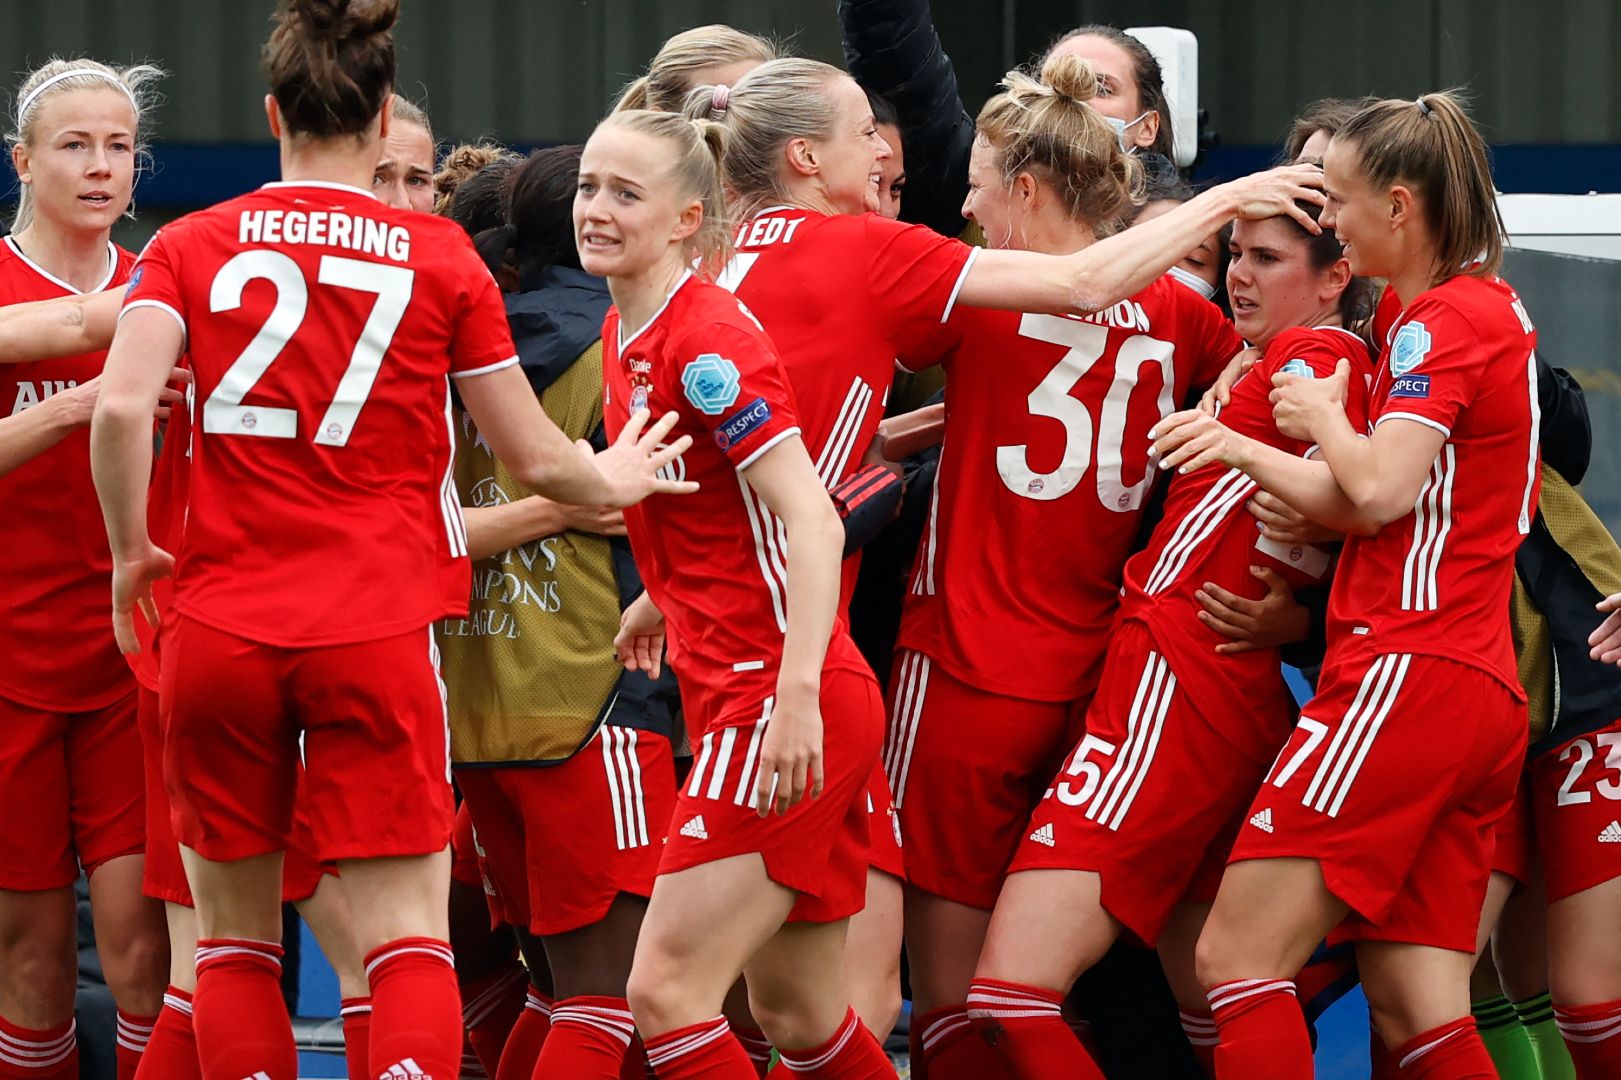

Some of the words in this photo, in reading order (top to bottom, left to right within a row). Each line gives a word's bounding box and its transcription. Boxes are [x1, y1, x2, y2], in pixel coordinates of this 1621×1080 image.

[239, 210, 410, 262] HEGERING
[203, 249, 414, 448] 27
[726, 401, 769, 439] RESPECT
[996, 312, 1176, 513] 30
[1391, 381, 1429, 393] SPECT
[1042, 733, 1116, 807] 5
[1262, 715, 1329, 789] 7
[1557, 731, 1621, 807] 23
